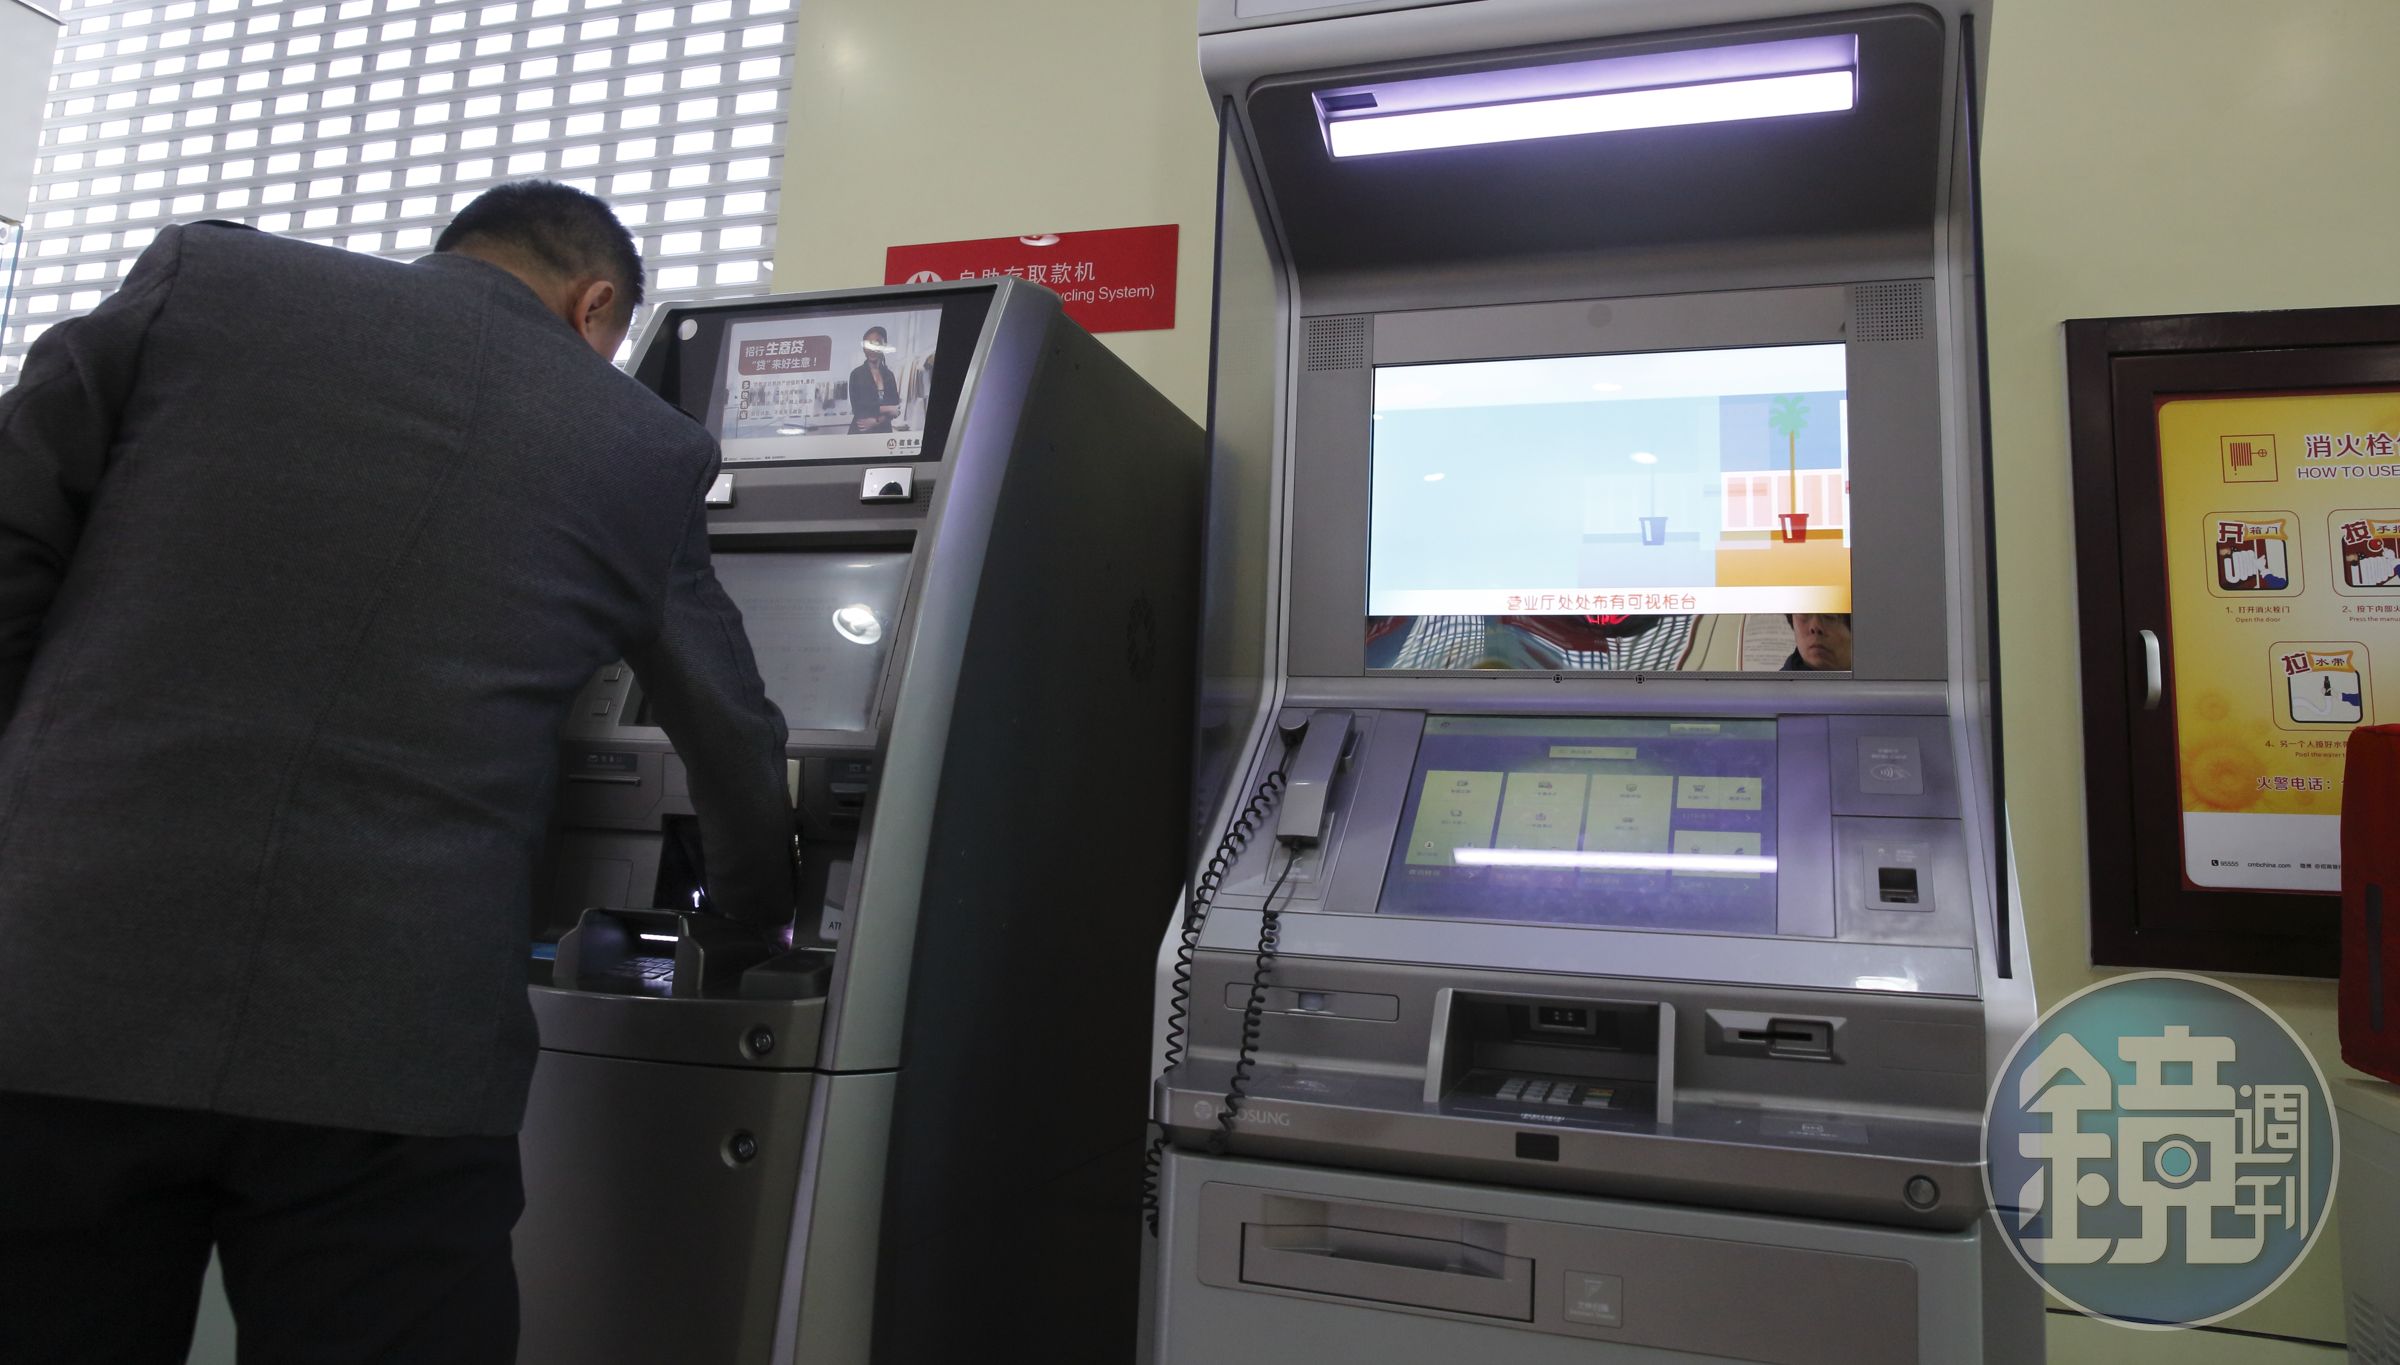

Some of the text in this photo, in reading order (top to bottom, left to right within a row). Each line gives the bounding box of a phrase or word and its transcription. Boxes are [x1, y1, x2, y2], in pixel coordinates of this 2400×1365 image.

[1098, 283, 1155, 301] System)
[2306, 433, 2400, 459] 消火栓
[2298, 465, 2400, 479] HOW TO USE
[2218, 522, 2244, 542] 开
[1506, 593, 1697, 611] 营业厅处处布有可视柜台
[2281, 653, 2311, 675] 拉
[1215, 1104, 1290, 1127] HOSUNG
